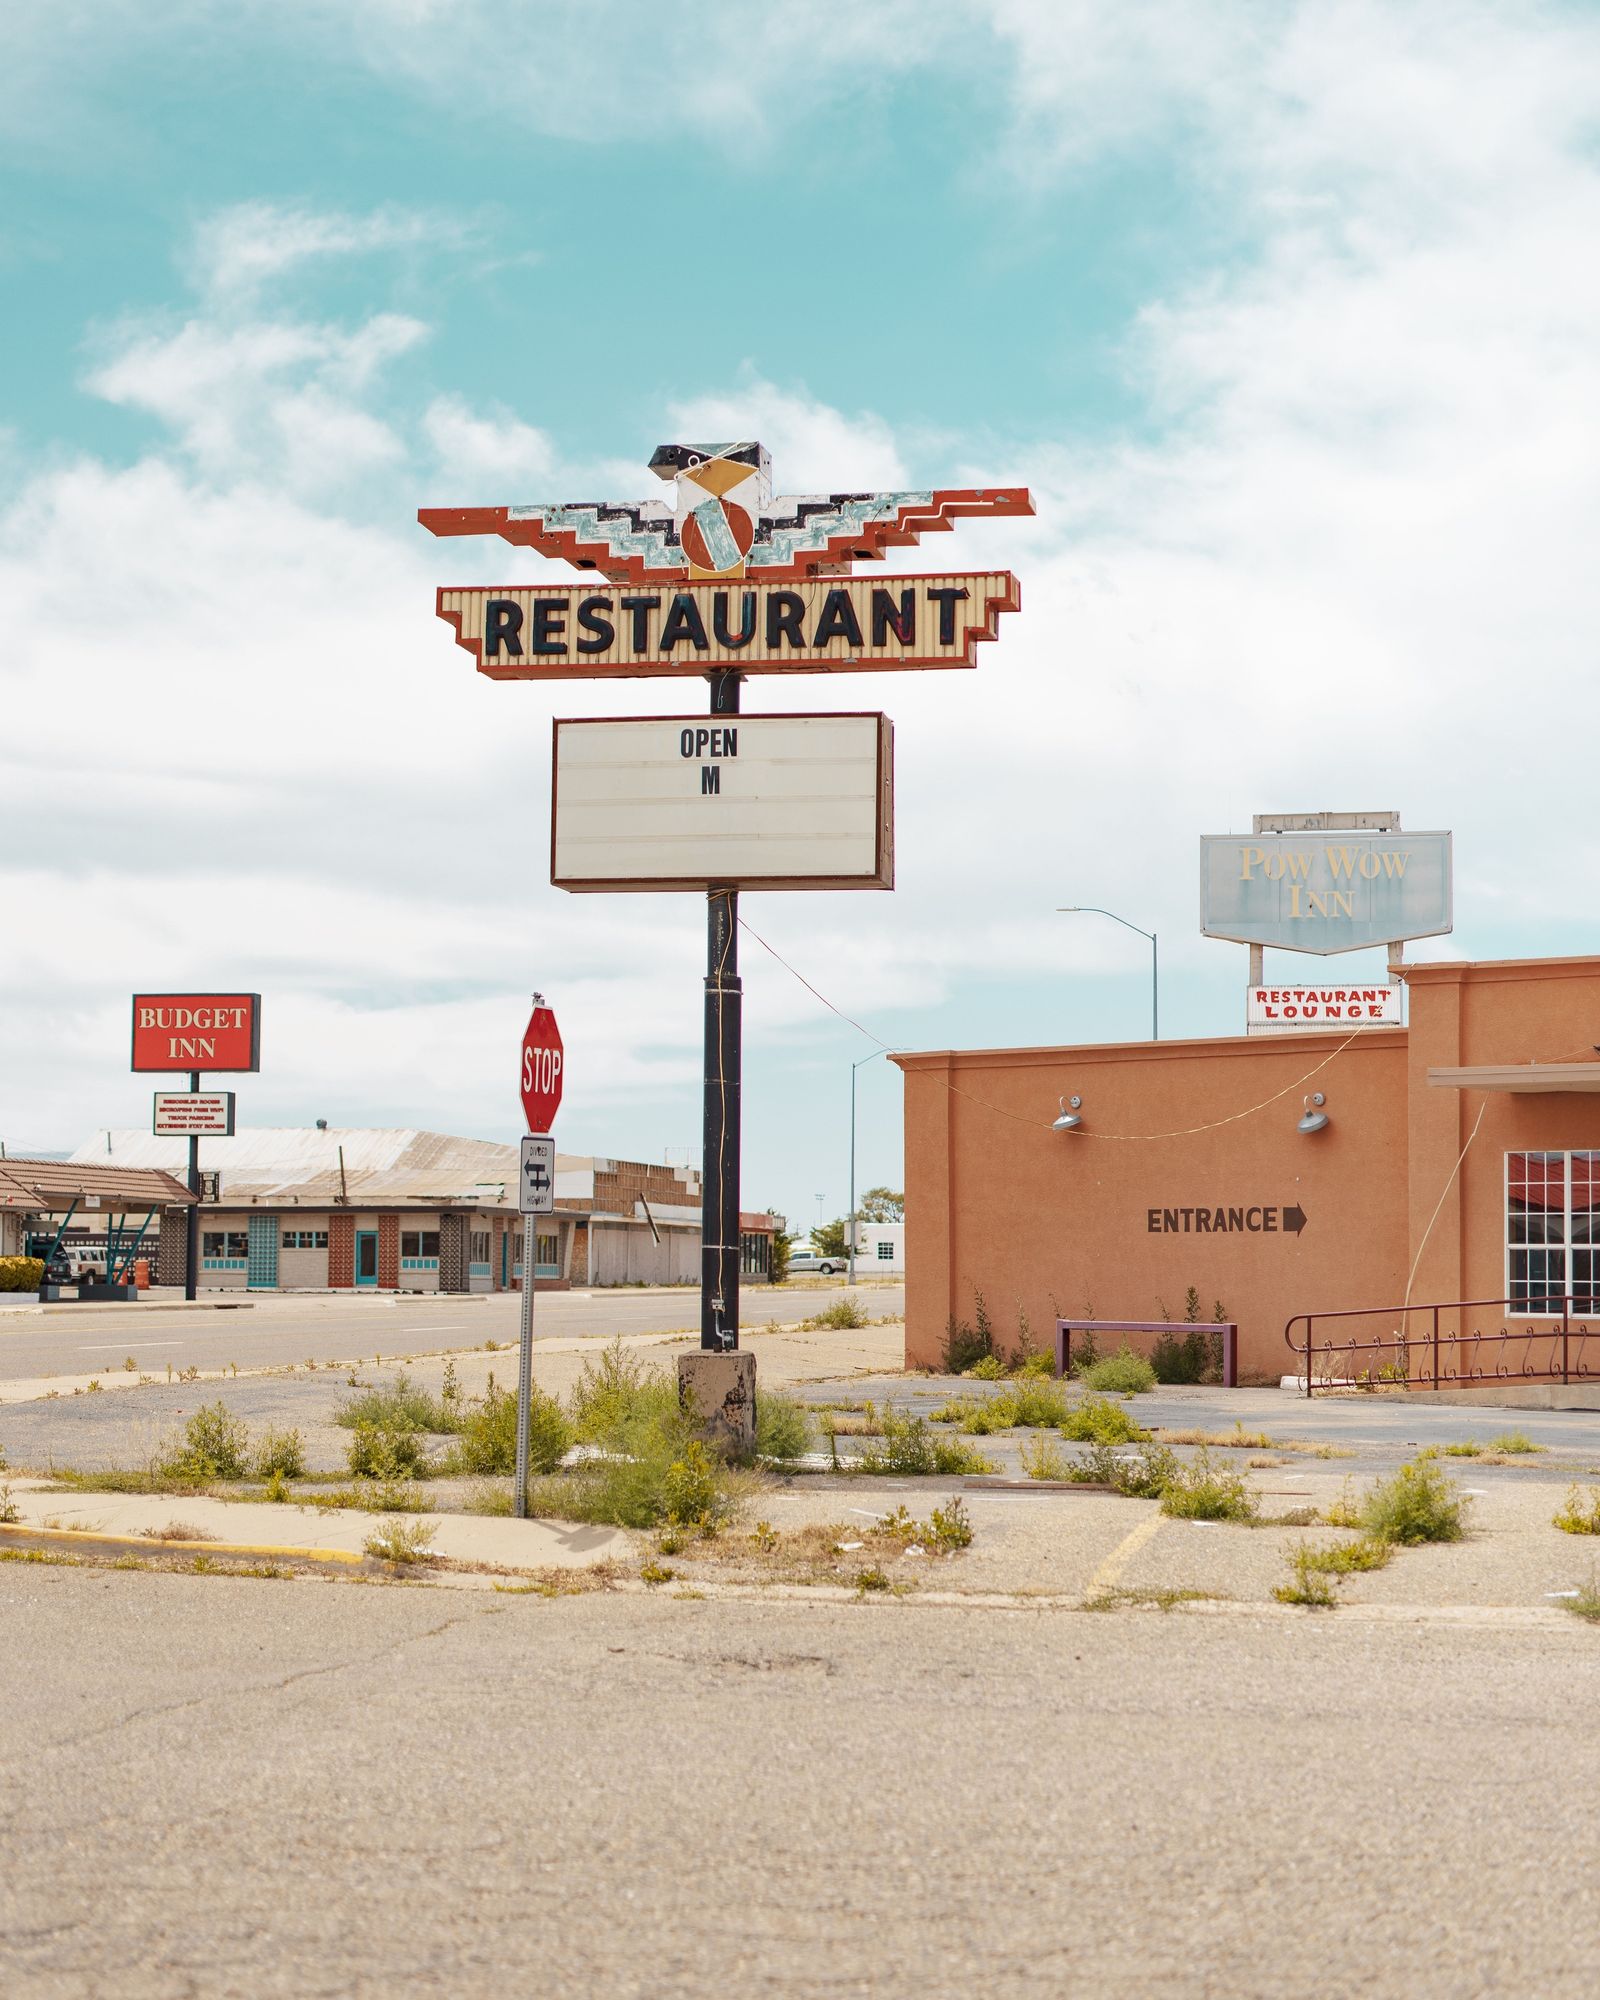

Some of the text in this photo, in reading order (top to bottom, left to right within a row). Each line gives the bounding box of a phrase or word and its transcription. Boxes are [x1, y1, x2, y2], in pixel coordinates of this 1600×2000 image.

[485, 586, 969, 656] RESTAURANT
[681, 729, 737, 758] OPEN
[702, 766, 720, 794] M
[1287, 884, 1355, 918] INN
[1256, 990, 1391, 1003] RESTAURANT
[139, 1008, 247, 1029] BUDGET
[1265, 1005, 1382, 1018] LOUNGE
[168, 1038, 216, 1058] INN
[523, 1046, 561, 1095] STOP
[530, 1146, 548, 1157] DIVDED
[1148, 1207, 1278, 1233] ENTRANCE
